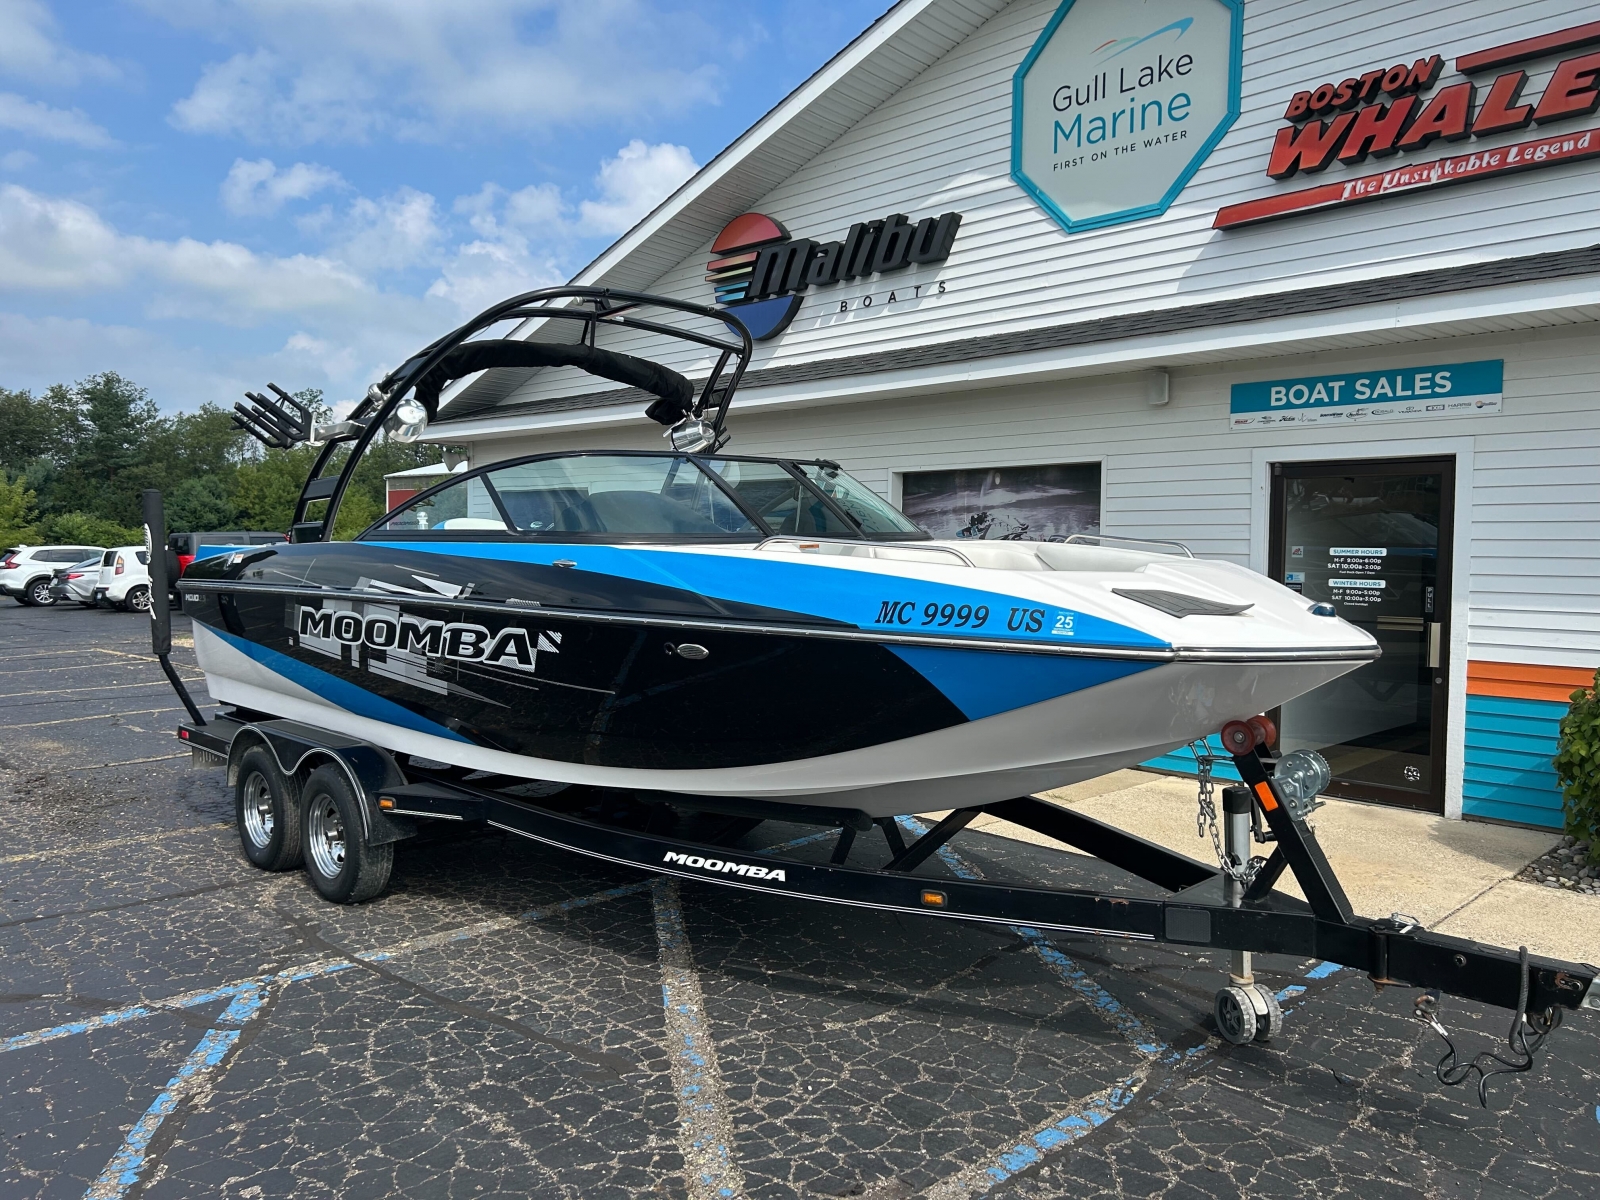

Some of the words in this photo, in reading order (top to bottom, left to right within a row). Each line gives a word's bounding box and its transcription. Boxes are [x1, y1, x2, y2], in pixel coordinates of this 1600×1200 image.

[1052, 72, 1107, 112] Gull
[1119, 53, 1193, 94] Lake
[1284, 54, 1444, 121] BOSTON
[1053, 92, 1192, 154] Marine
[1053, 156, 1085, 172] FIRST
[1091, 150, 1108, 162] ON
[1114, 143, 1137, 156] THE
[1143, 130, 1188, 148] WATER
[1342, 181, 1377, 201] The
[1380, 153, 1500, 193] Unsinkable
[1506, 132, 1592, 163] Legend
[840, 281, 946, 312] BOATS
[1270, 381, 1345, 407] BOAT
[1354, 371, 1452, 399] SALES
[299, 606, 536, 669] MOOMBA
[874, 601, 916, 625] MC
[921, 602, 990, 629] 9999
[1007, 607, 1046, 633] US
[1055, 615, 1074, 629] 25
[662, 851, 786, 882] MOOMBA
